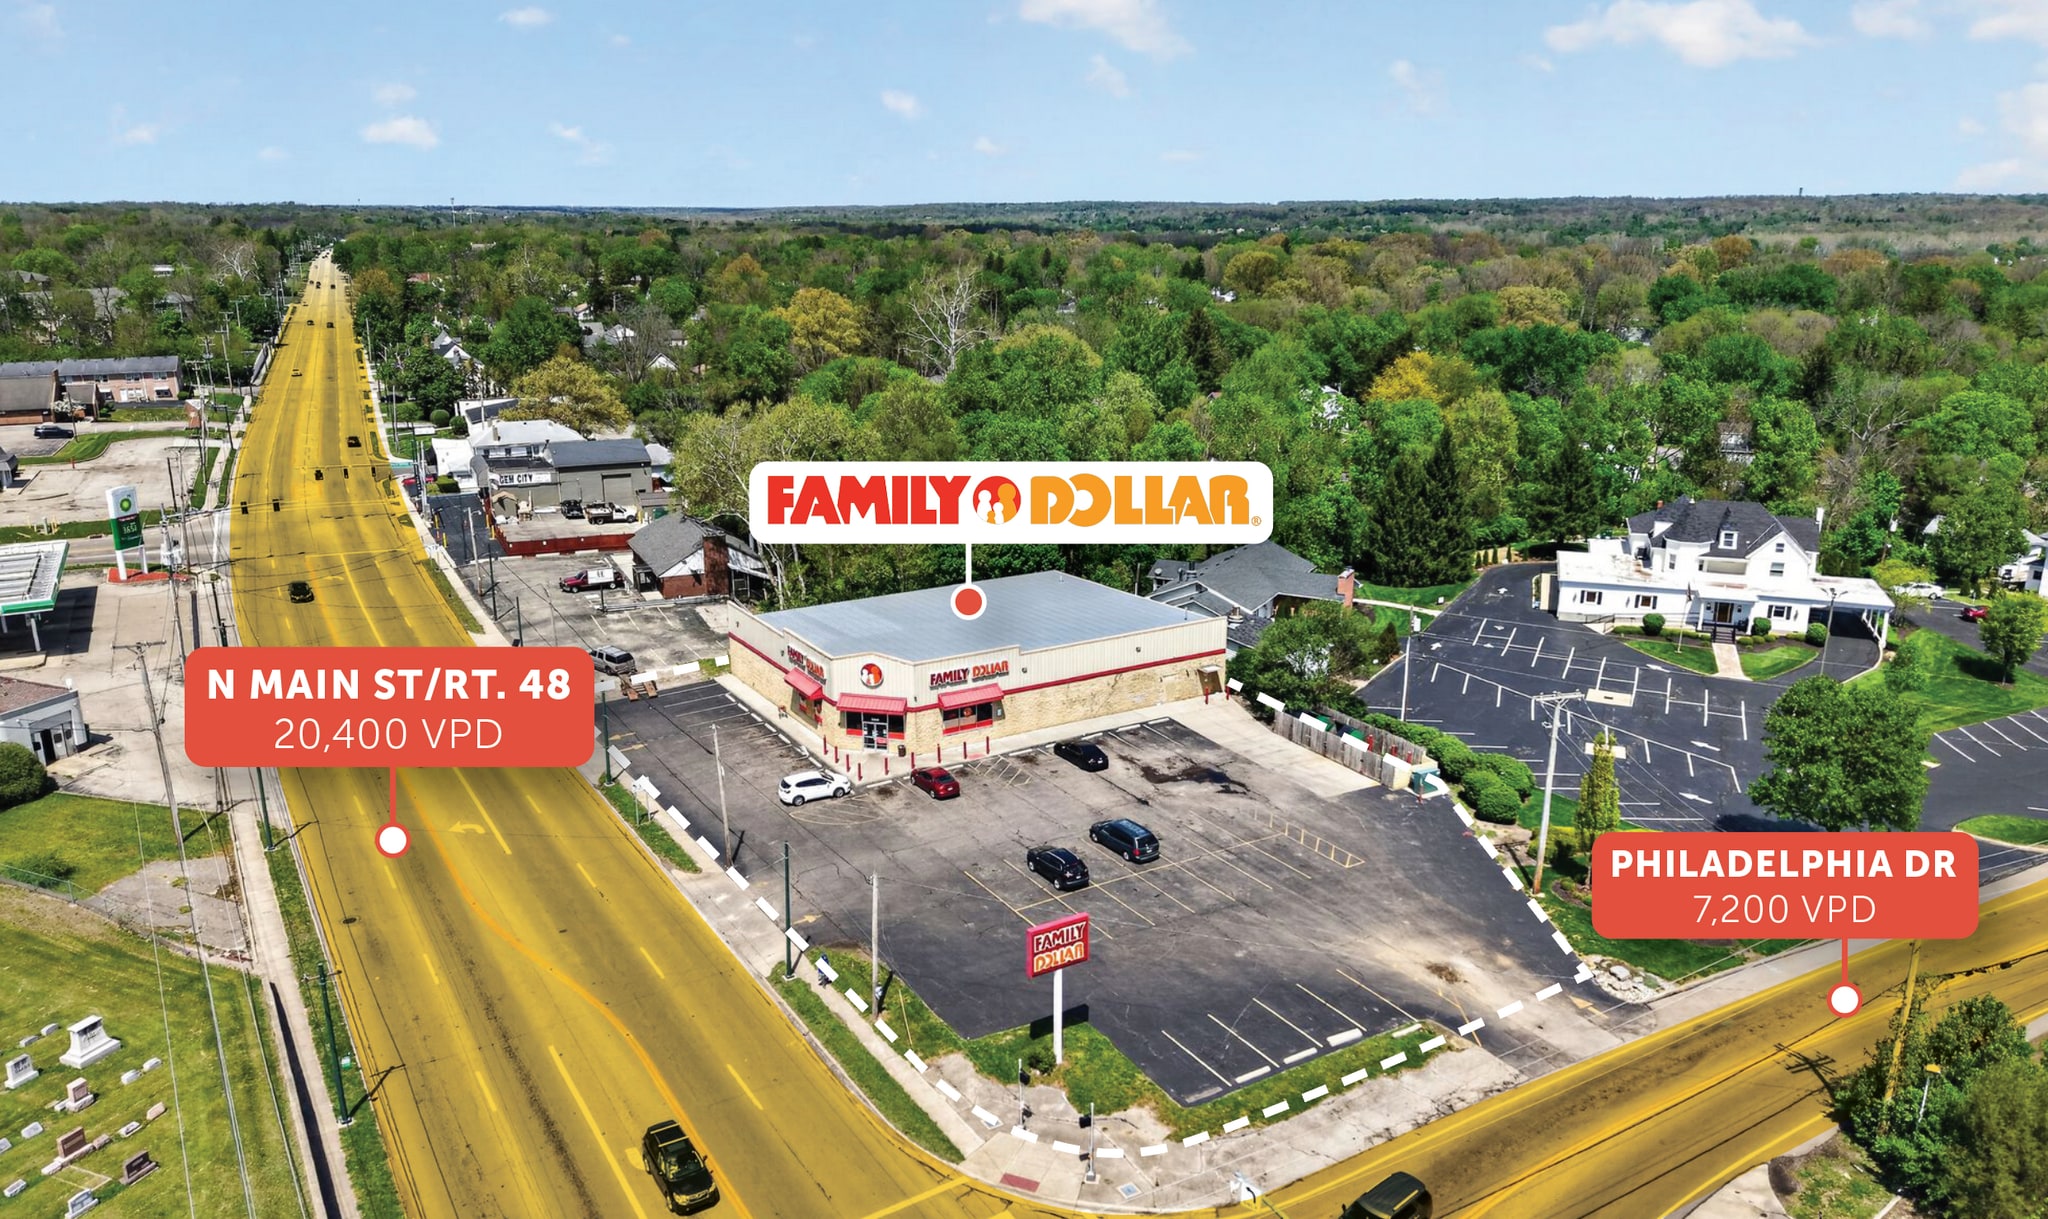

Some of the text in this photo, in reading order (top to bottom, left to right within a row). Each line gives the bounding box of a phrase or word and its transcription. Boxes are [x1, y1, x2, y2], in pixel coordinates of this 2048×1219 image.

[499, 474, 515, 484] GEM
[517, 473, 533, 483] CITY
[930, 660, 1008, 685] FAMILY DOLLAR
[1034, 922, 1086, 953] FAMILY
[1034, 941, 1084, 972] DOLLAR
